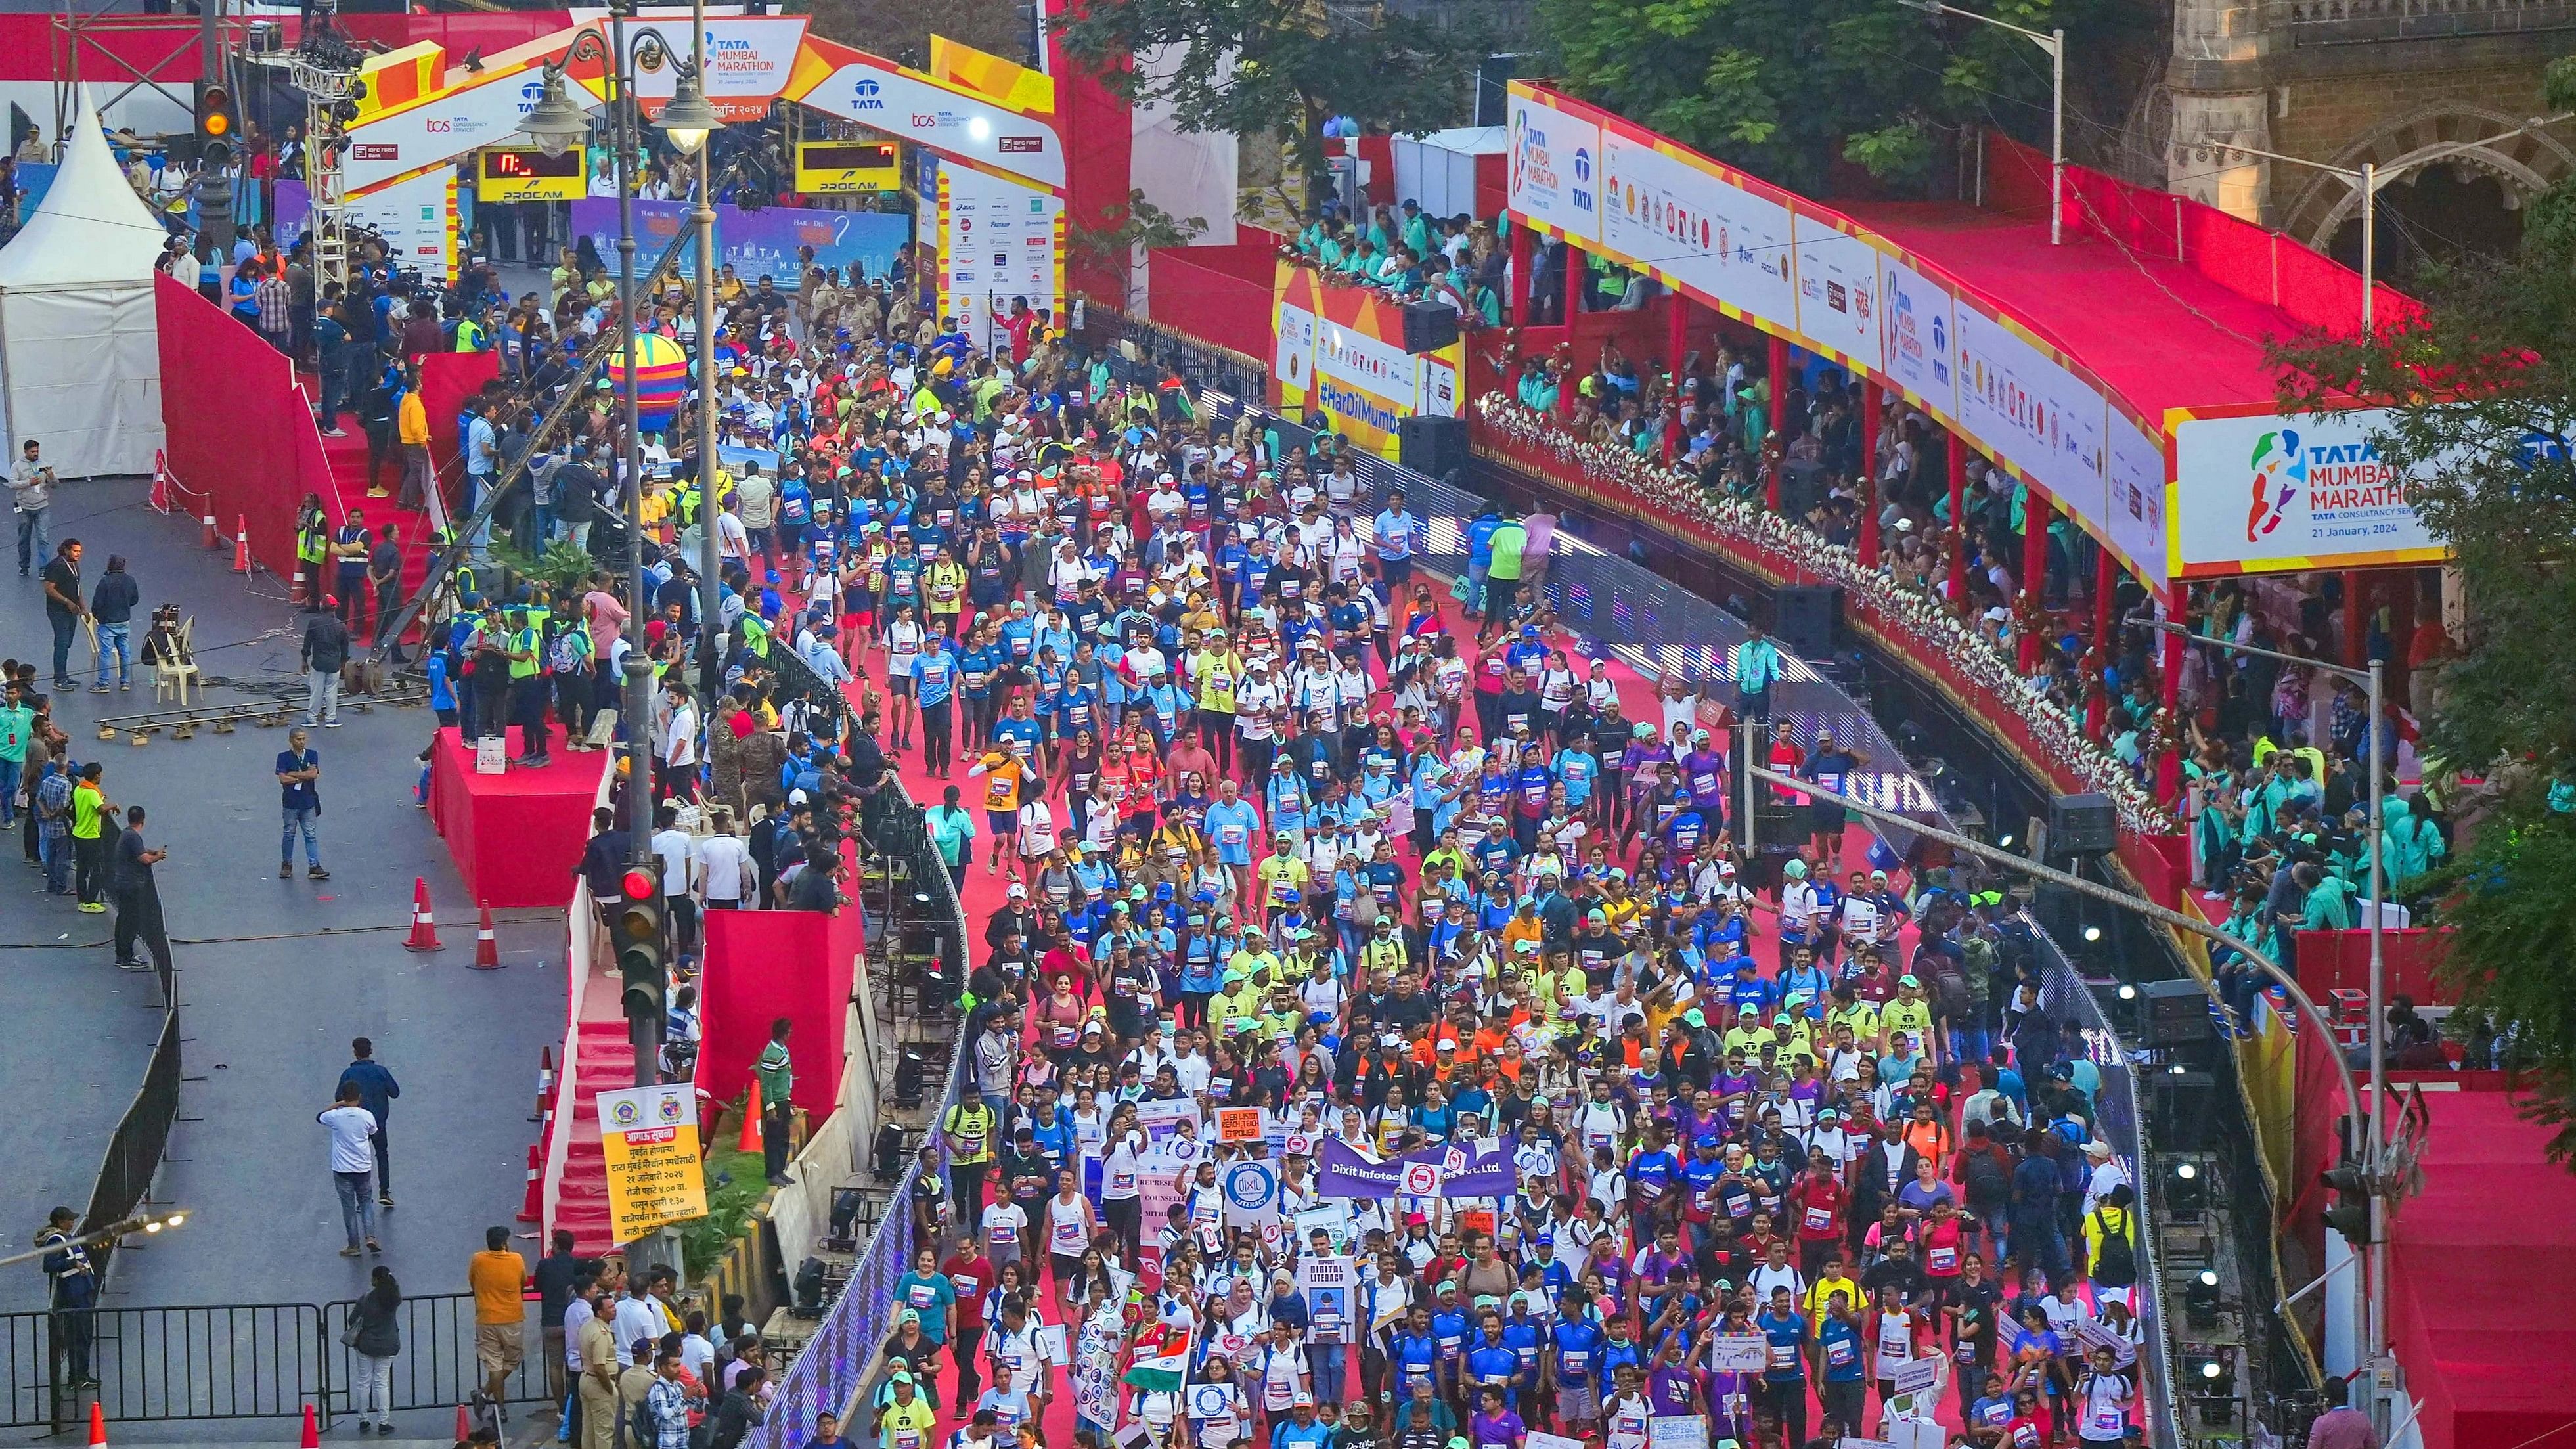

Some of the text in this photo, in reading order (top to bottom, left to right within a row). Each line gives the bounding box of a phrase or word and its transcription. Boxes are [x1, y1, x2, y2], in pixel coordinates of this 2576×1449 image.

[718, 51, 757, 60] MUMBAI
[718, 61, 774, 71] MARATHON
[852, 100, 883, 109] TATA
[427, 118, 449, 132] tcs
[913, 113, 935, 127] tcs
[1529, 129, 1545, 147] TATA
[1529, 146, 1549, 167] MUMBAI
[1528, 166, 1558, 190] MARATHON
[1572, 188, 1592, 212] TATA
[1898, 291, 1911, 313] TATA
[1933, 359, 1948, 387] TATA
[2309, 444, 2379, 464] TATA
[2310, 464, 2399, 487] MUMBAI
[2338, 508, 2395, 519] CONSULTANCY
[2327, 527, 2370, 537] January,
[2373, 524, 2397, 533] 2024
[627, 1128, 674, 1143] आगाऊ सूचना
[629, 1146, 648, 1159] मुंबईत
[627, 1160, 642, 1172] मुंबई
[1235, 1164, 1261, 1172] DIGITAL
[1331, 1163, 1357, 1175] Dixit
[1482, 1163, 1501, 1173] Ltd.
[626, 1170, 684, 1184] २१ जानेवारी २०२४
[625, 1187, 640, 1196] रोजी
[642, 1185, 657, 1195] पहाटे
[1239, 1177, 1261, 1192] dixit
[631, 1201, 648, 1210] पासून
[650, 1197, 667, 1209] दुपारी
[1235, 1197, 1266, 1207] LITERACY
[651, 1213, 658, 1221] हा
[676, 1206, 697, 1217] रहदारी
[623, 1226, 640, 1236] साठी
